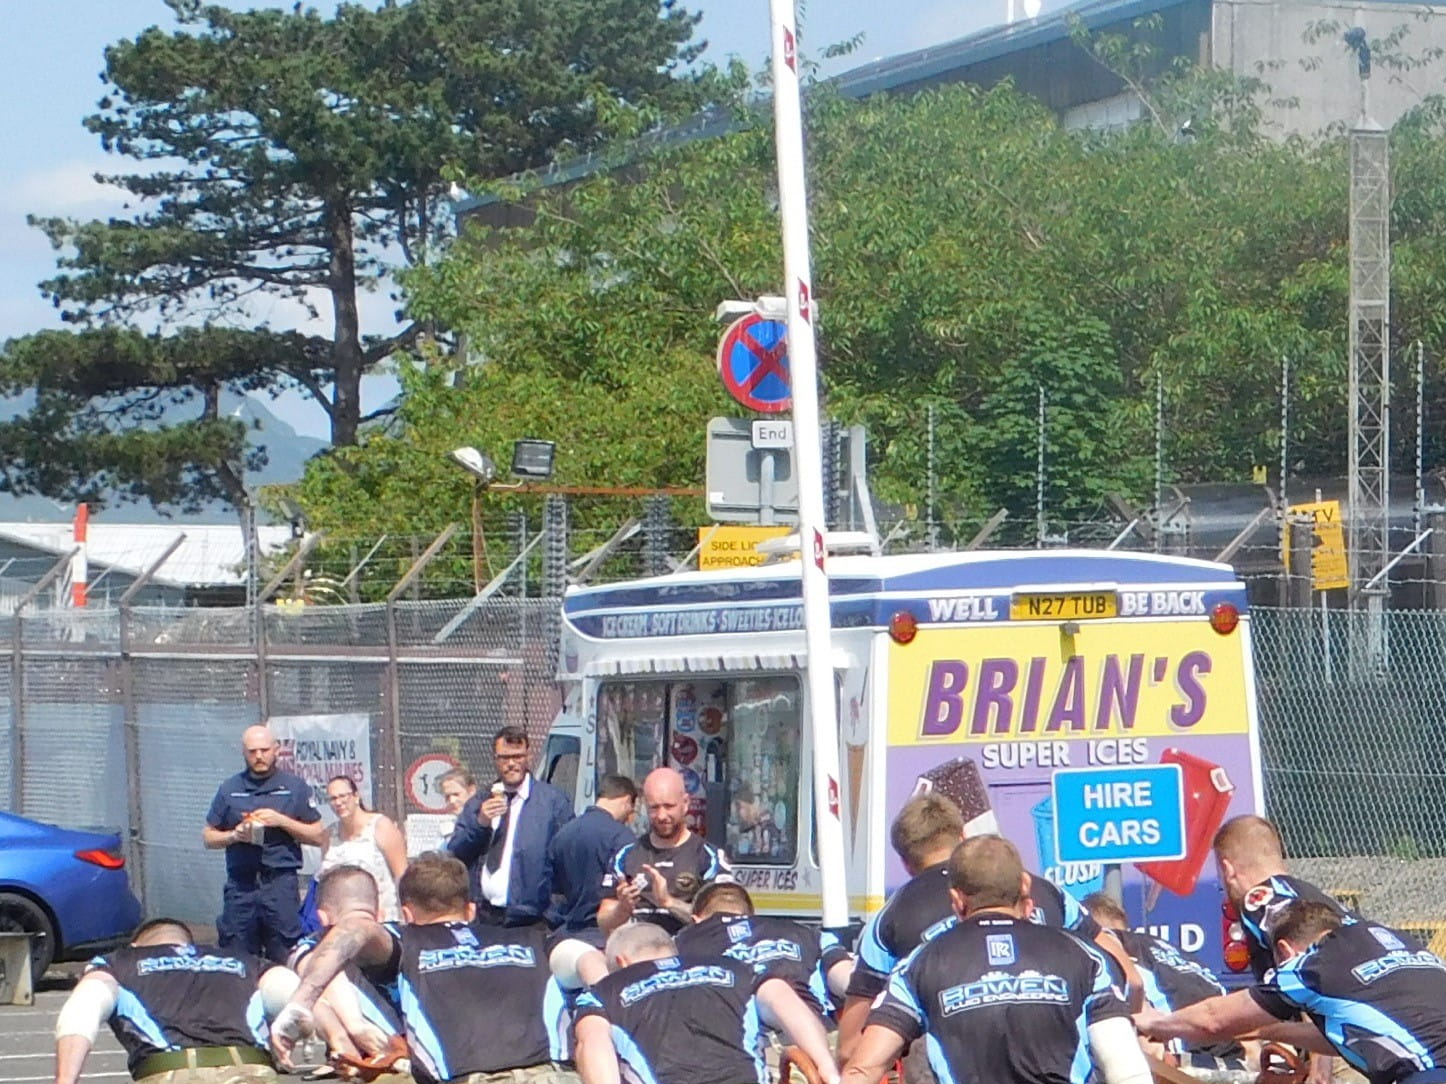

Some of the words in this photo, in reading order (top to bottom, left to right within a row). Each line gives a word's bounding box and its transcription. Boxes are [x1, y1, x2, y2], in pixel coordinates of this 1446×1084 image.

[759, 426, 787, 441] End
[711, 541, 737, 551] SIDE
[1029, 598, 1066, 616] N27
[1071, 596, 1106, 614] TUB
[1120, 591, 1149, 616] BE
[1150, 591, 1206, 615] BACK
[720, 607, 771, 632] SWEETIES
[919, 650, 1213, 738] BRIAN'S
[982, 740, 1071, 769] SUPER
[1087, 738, 1148, 765] ICES
[1083, 781, 1153, 809] HIRE
[1078, 819, 1161, 848] CARS
[773, 870, 799, 890] ICES
[942, 978, 1068, 1006] BOWEN
[945, 997, 981, 1014] FLUID
